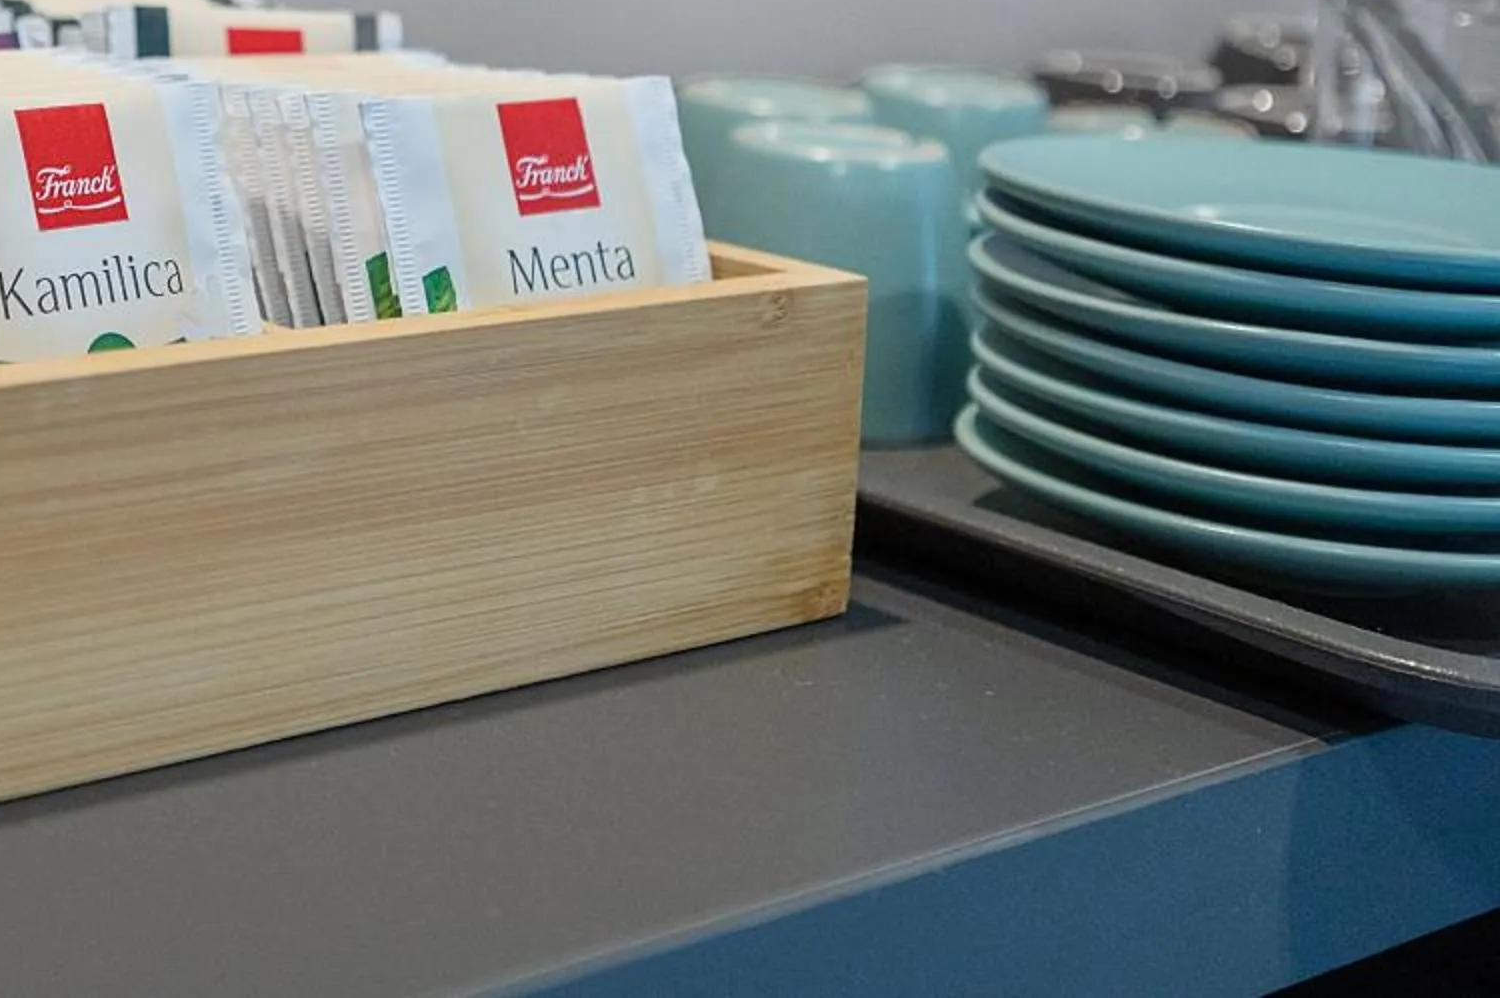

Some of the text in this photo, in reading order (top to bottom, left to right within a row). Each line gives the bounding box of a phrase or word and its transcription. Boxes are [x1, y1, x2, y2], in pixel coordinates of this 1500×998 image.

[35, 165, 117, 200] Franck
[516, 155, 591, 186] Franck
[507, 241, 636, 295] Menta
